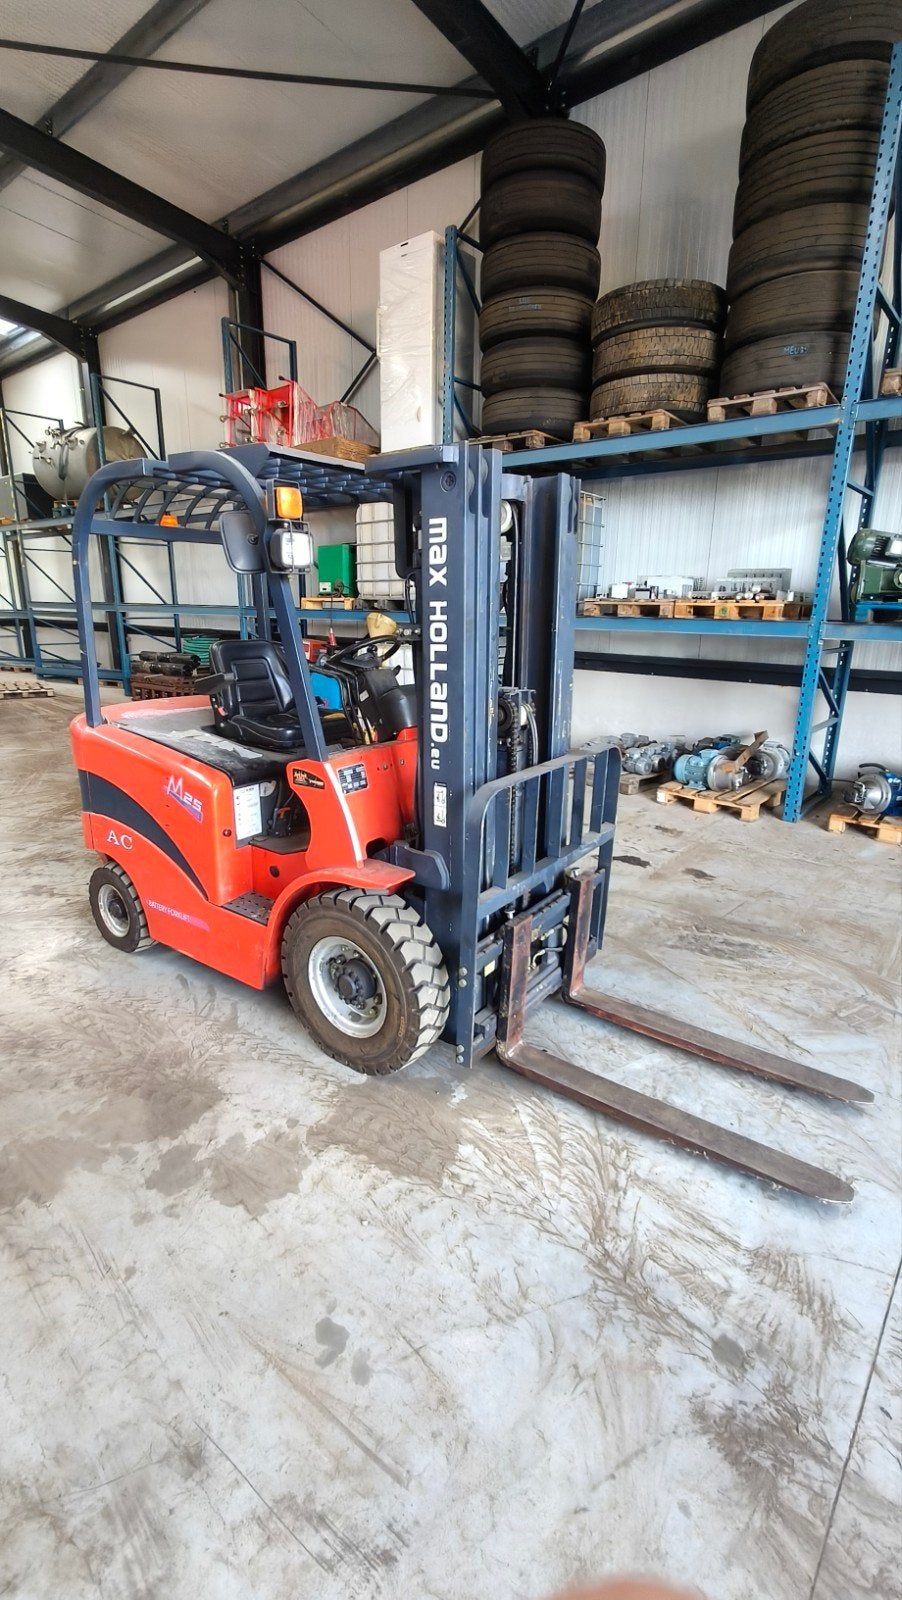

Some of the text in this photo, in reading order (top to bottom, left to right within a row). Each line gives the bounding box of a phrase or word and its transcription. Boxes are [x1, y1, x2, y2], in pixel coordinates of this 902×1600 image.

[429, 517, 448, 587] max
[166, 774, 203, 812] M25
[106, 829, 133, 850] AC
